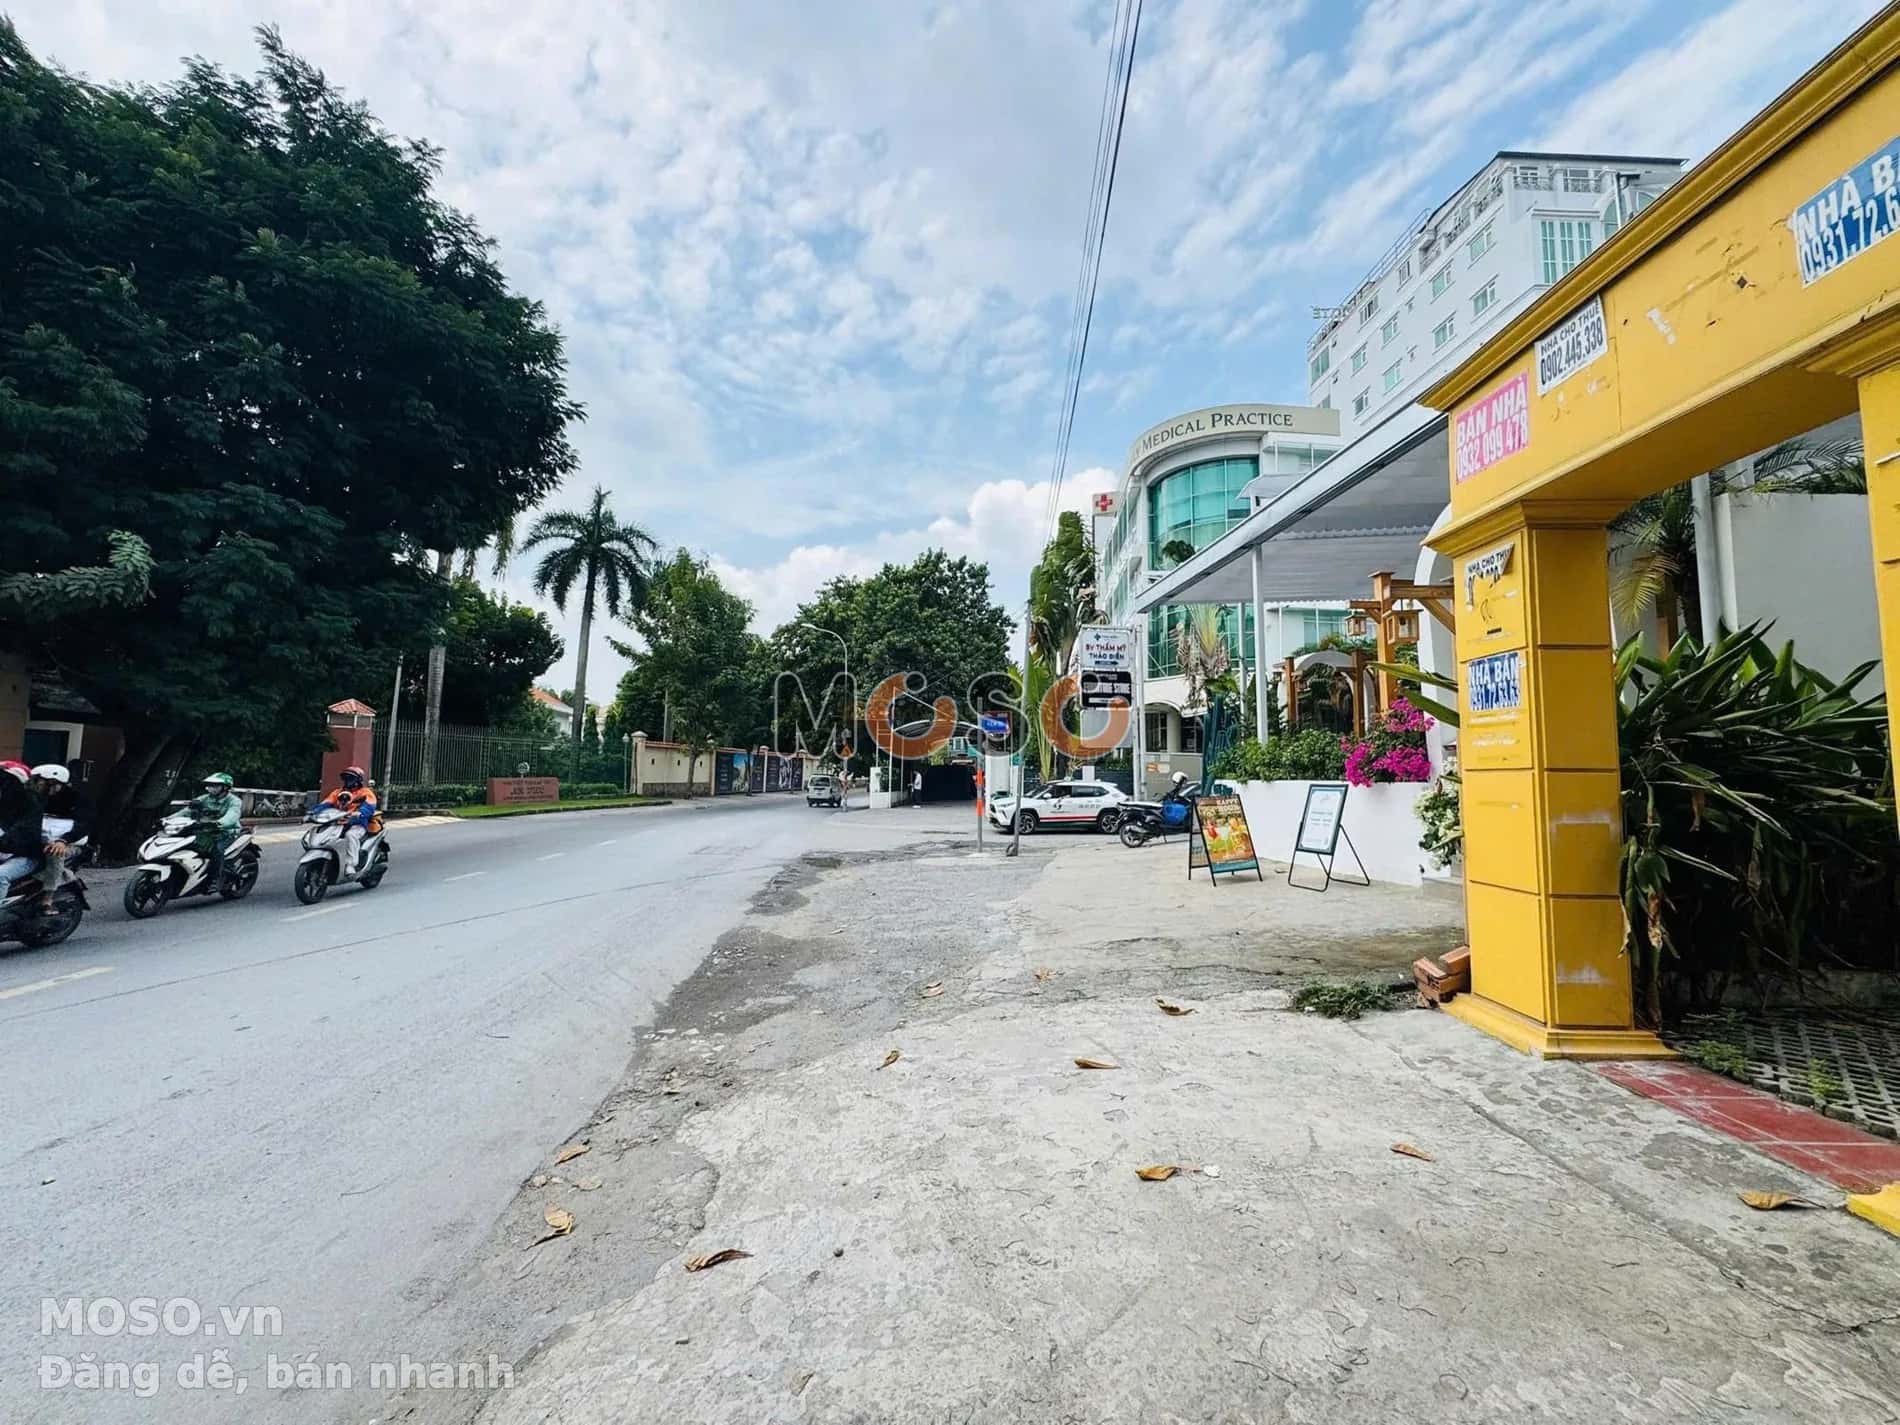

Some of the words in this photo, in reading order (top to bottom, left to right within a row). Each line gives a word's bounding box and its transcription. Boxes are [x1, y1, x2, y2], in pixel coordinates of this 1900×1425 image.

[1799, 174, 1862, 242] NHÀ
[1872, 154, 1900, 196] B
[1540, 316, 1604, 385] 0902.445.338
[1560, 321, 1577, 341] CHO
[1141, 419, 1206, 451] MEDICAL
[1211, 413, 1293, 428] PRACTICE
[1457, 405, 1488, 447] BÁN
[1491, 377, 1527, 426] NHÀ
[1456, 437, 1481, 480] 0932
[1483, 425, 1504, 465] 099
